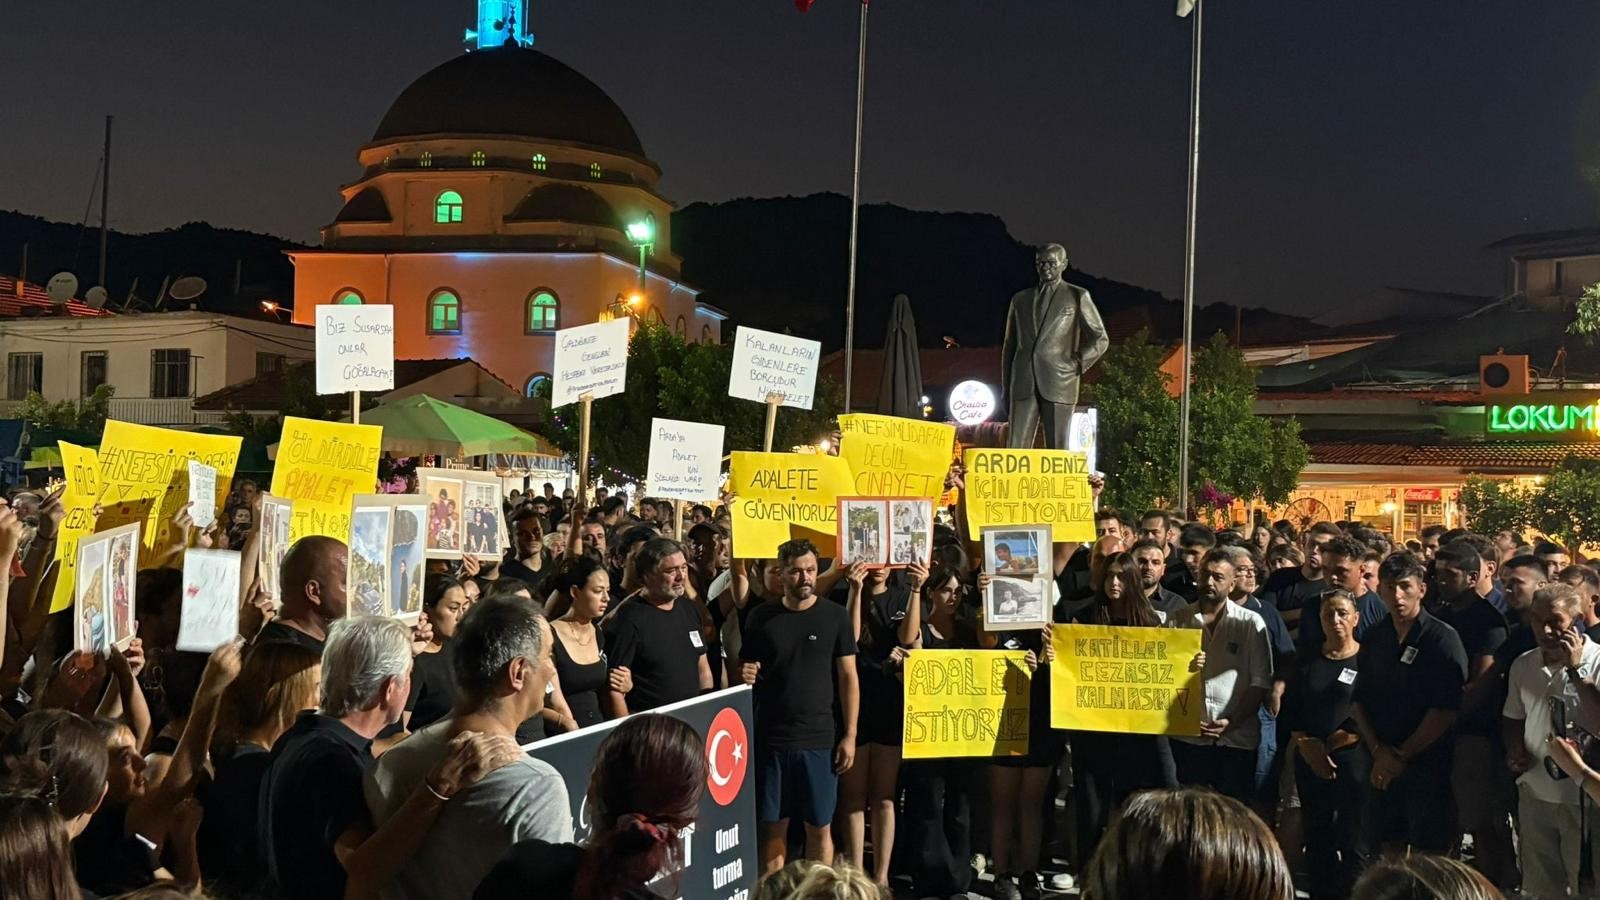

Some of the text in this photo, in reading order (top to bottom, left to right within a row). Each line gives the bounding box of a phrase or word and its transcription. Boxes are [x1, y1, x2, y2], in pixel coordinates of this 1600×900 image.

[1492, 405, 1592, 431] LOKUM
[975, 453, 1088, 474] ARDA DENİZ
[750, 469, 818, 490] ADALETE
[975, 476, 1087, 499] İÇİN ADALET
[744, 496, 837, 522] GÜVENİYORUZ
[985, 501, 1094, 523] İSTİYORUZ
[1075, 634, 1167, 660] KATİLLER
[909, 657, 1027, 695] ADALET
[1080, 661, 1174, 684] CEZASIZ
[1076, 686, 1170, 711] KALMASIN
[905, 705, 1027, 743] İSTİYORUZ
[715, 823, 739, 854] Unut
[712, 858, 743, 890] turma
